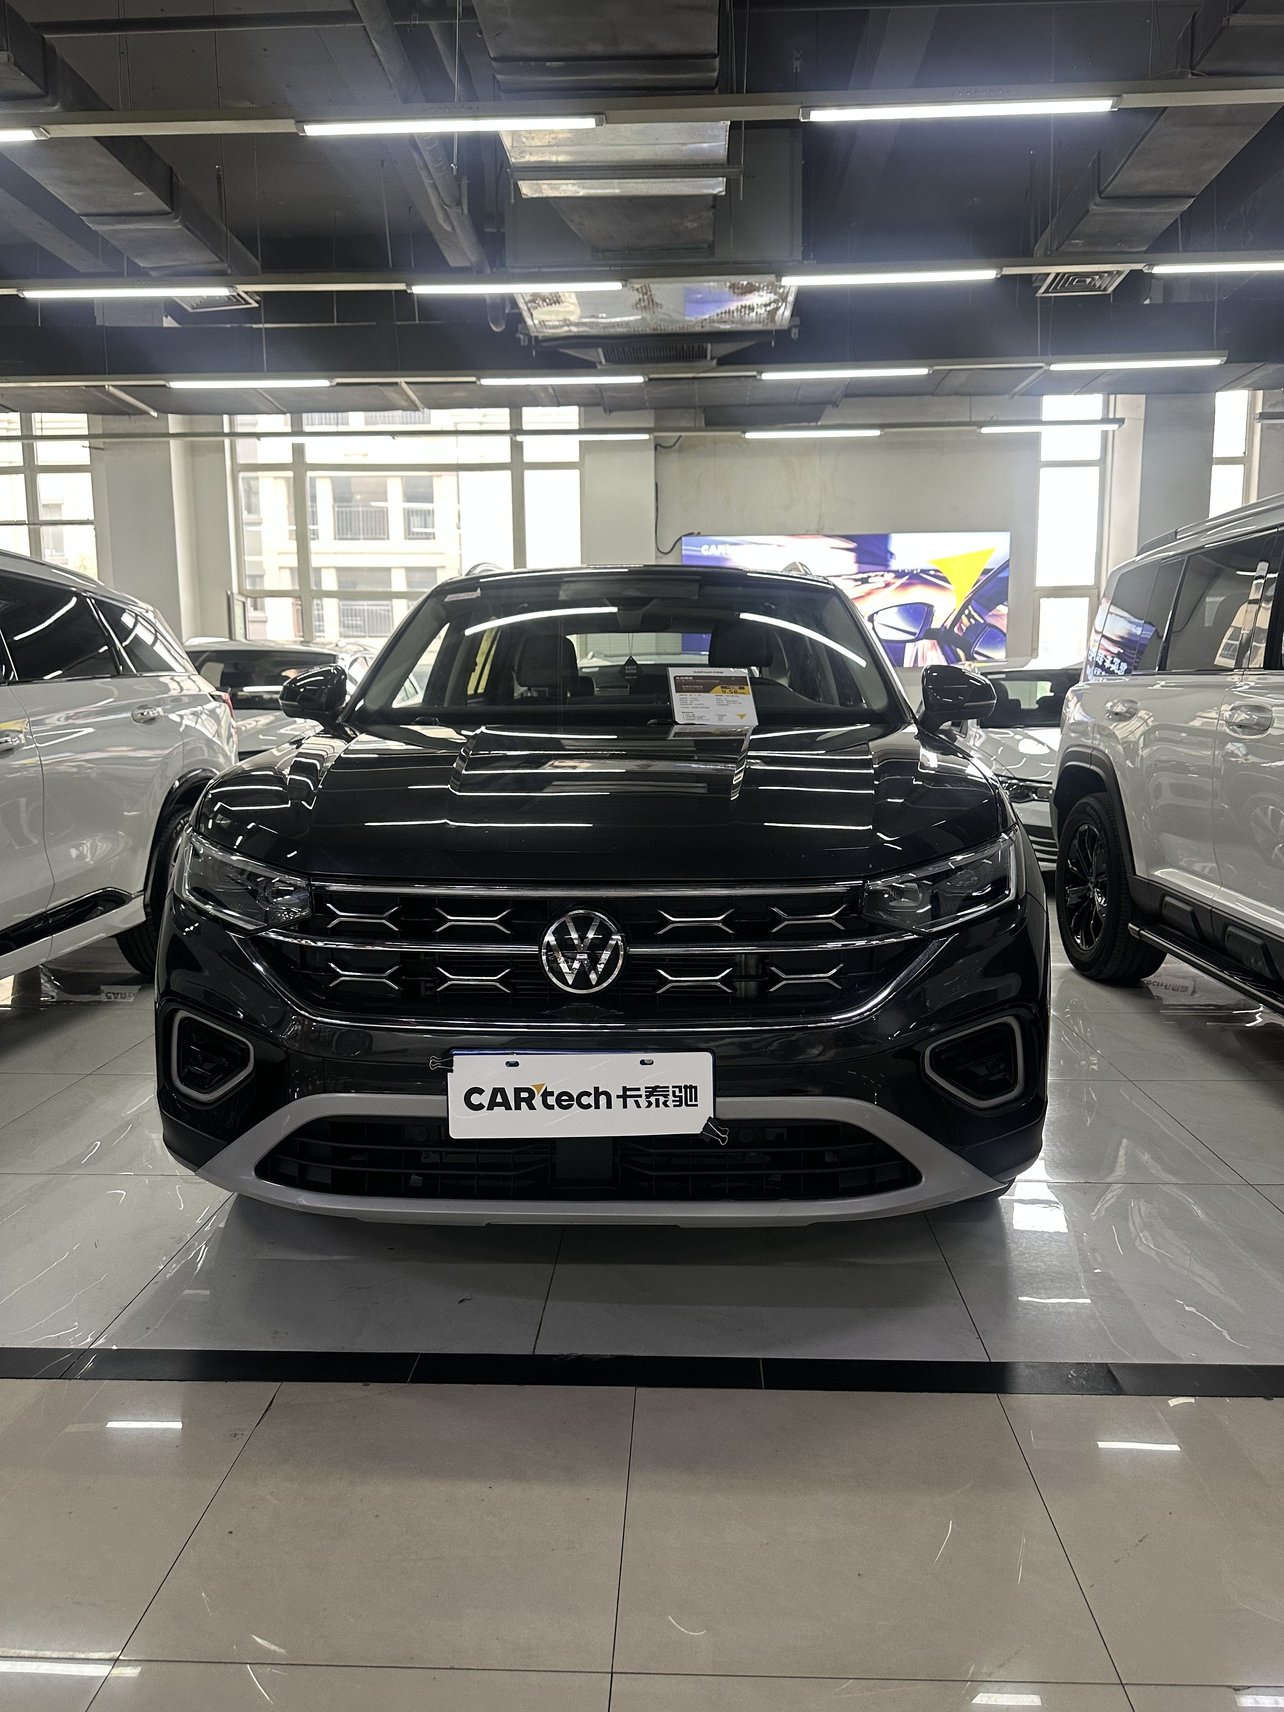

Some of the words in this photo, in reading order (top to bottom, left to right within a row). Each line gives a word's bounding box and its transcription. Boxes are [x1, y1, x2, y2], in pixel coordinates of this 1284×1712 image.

[463, 1084, 613, 1112] CARtech
[616, 1083, 699, 1110] 卡泰驰
